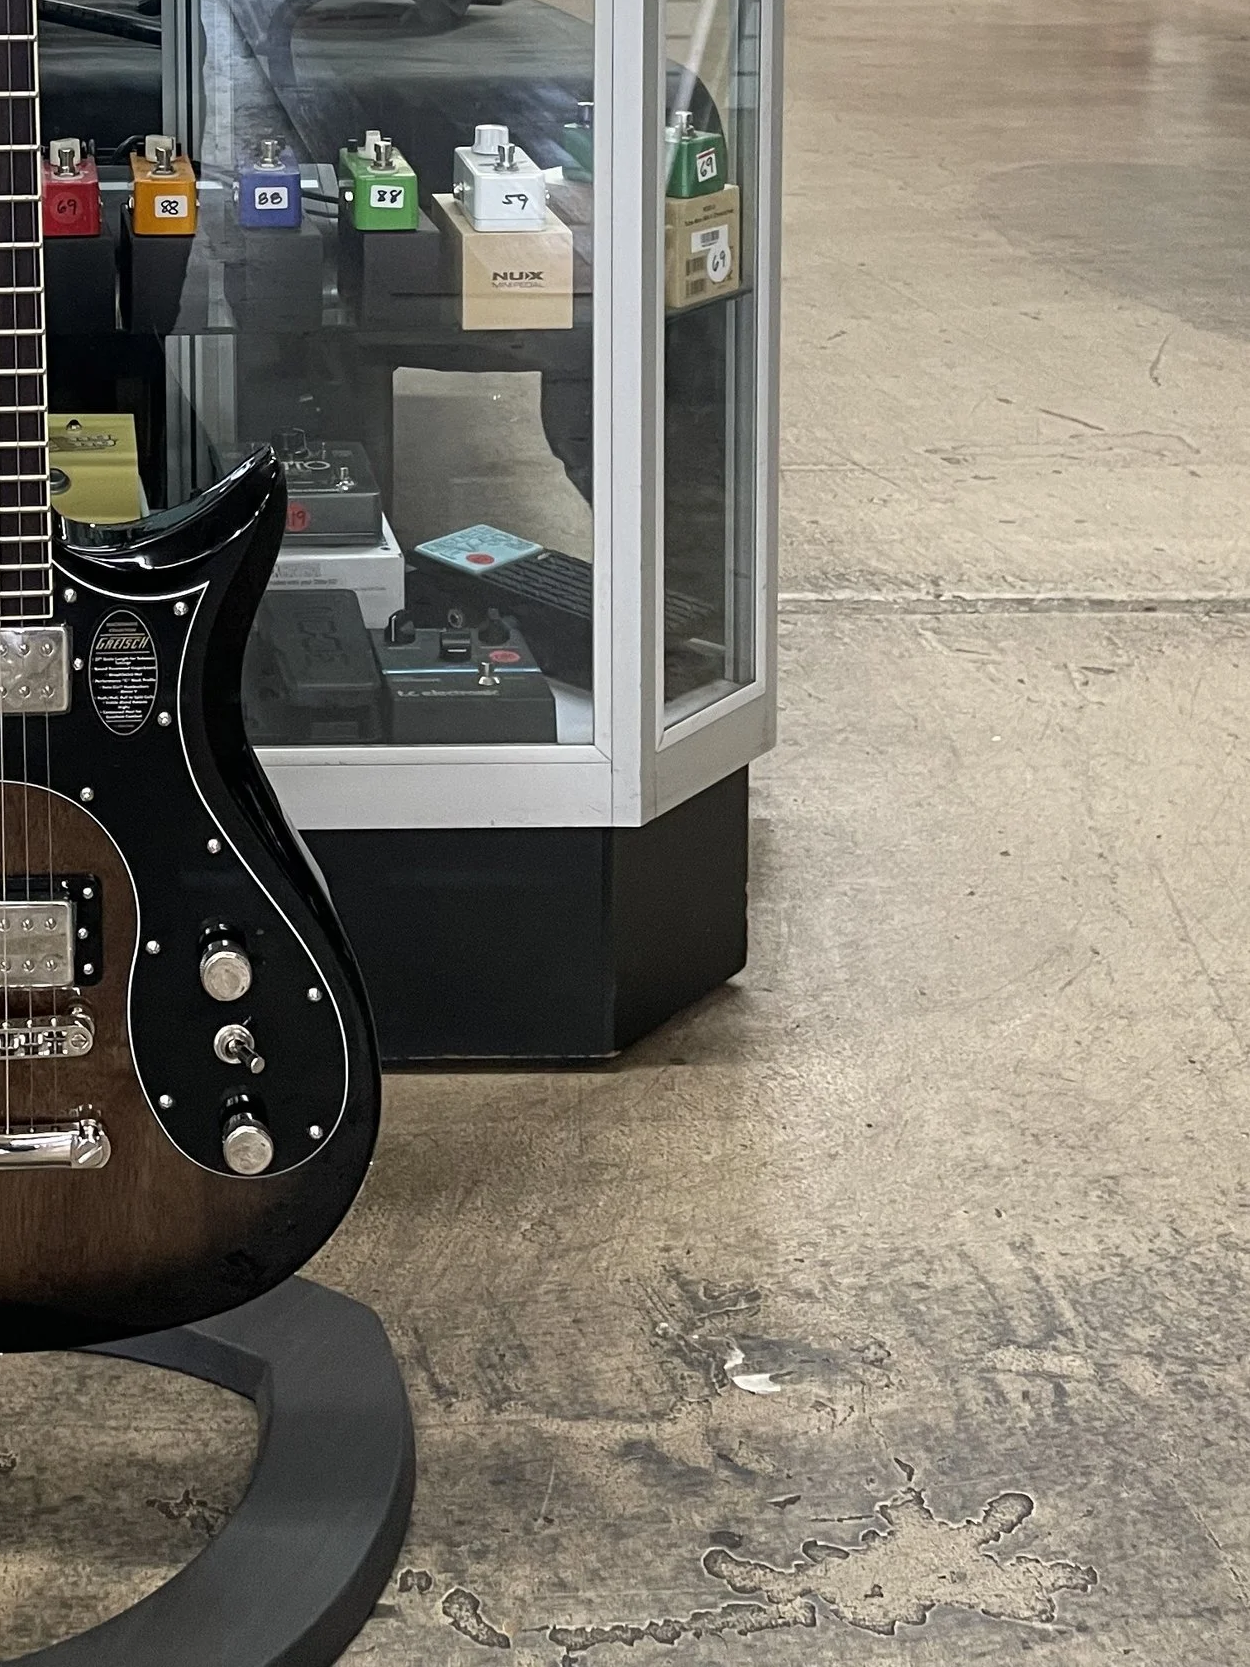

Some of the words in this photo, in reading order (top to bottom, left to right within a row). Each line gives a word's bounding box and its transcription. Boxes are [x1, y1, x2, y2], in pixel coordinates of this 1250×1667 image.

[699, 156, 714, 178] 69
[56, 198, 78, 216] 69
[258, 191, 283, 206] 88
[160, 199, 180, 216] 88
[711, 249, 727, 273] 69
[492, 270, 545, 281] NUX
[95, 635, 150, 650] GRETSCH
